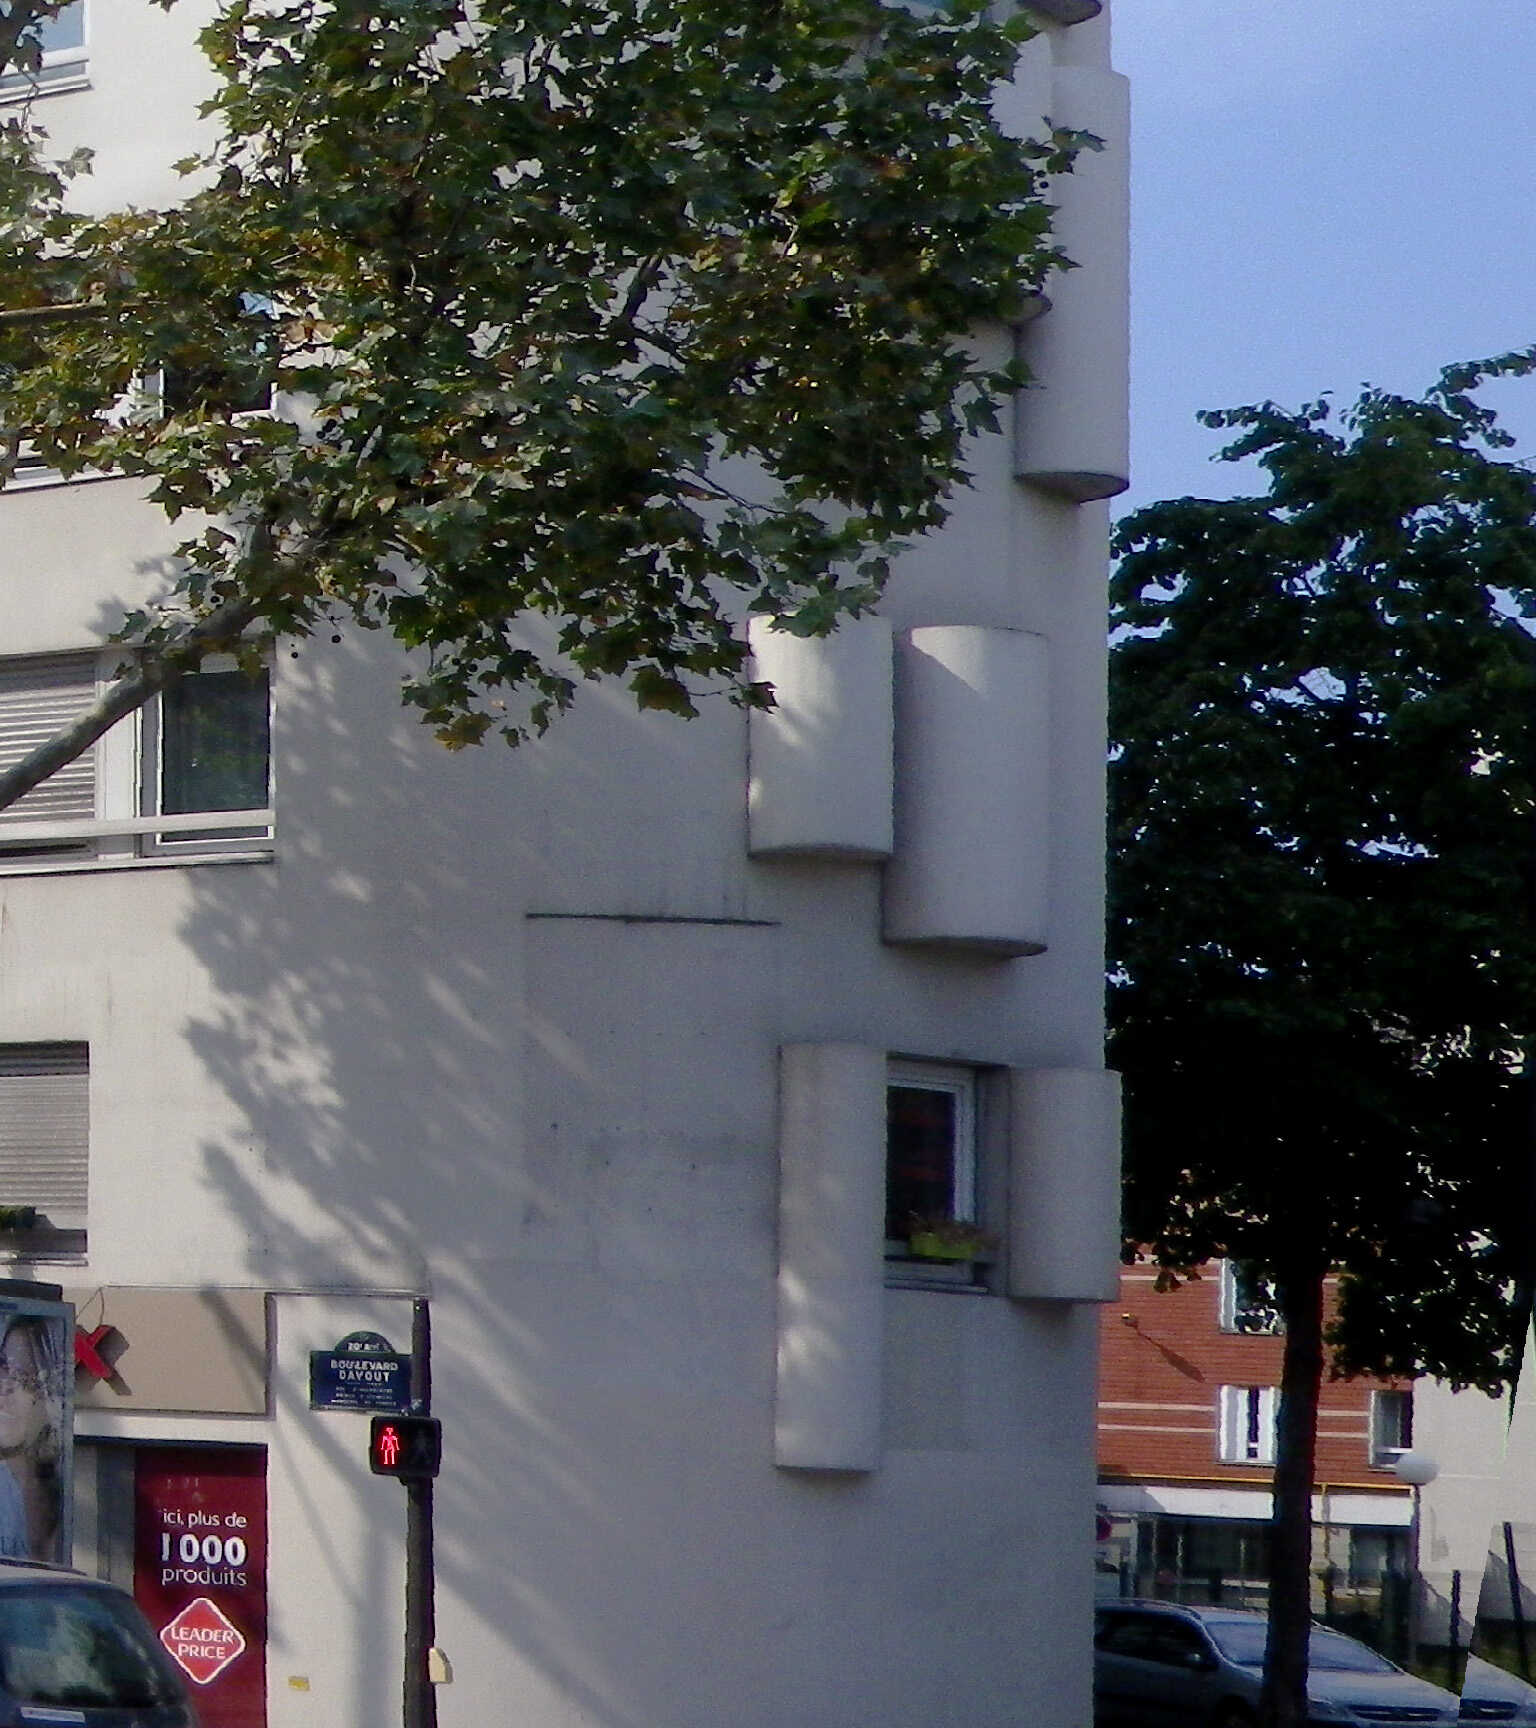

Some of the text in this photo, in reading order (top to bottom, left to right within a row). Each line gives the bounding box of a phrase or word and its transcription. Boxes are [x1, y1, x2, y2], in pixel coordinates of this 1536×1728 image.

[331, 1360, 399, 1371] BOULEVARD
[339, 1371, 390, 1382] DAVOUT
[163, 1509, 247, 1528] ici, plus de
[179, 1534, 247, 1566] 000
[162, 1568, 248, 1586] produits
[171, 1627, 234, 1645] LEADER
[179, 1644, 226, 1659] PRICE
